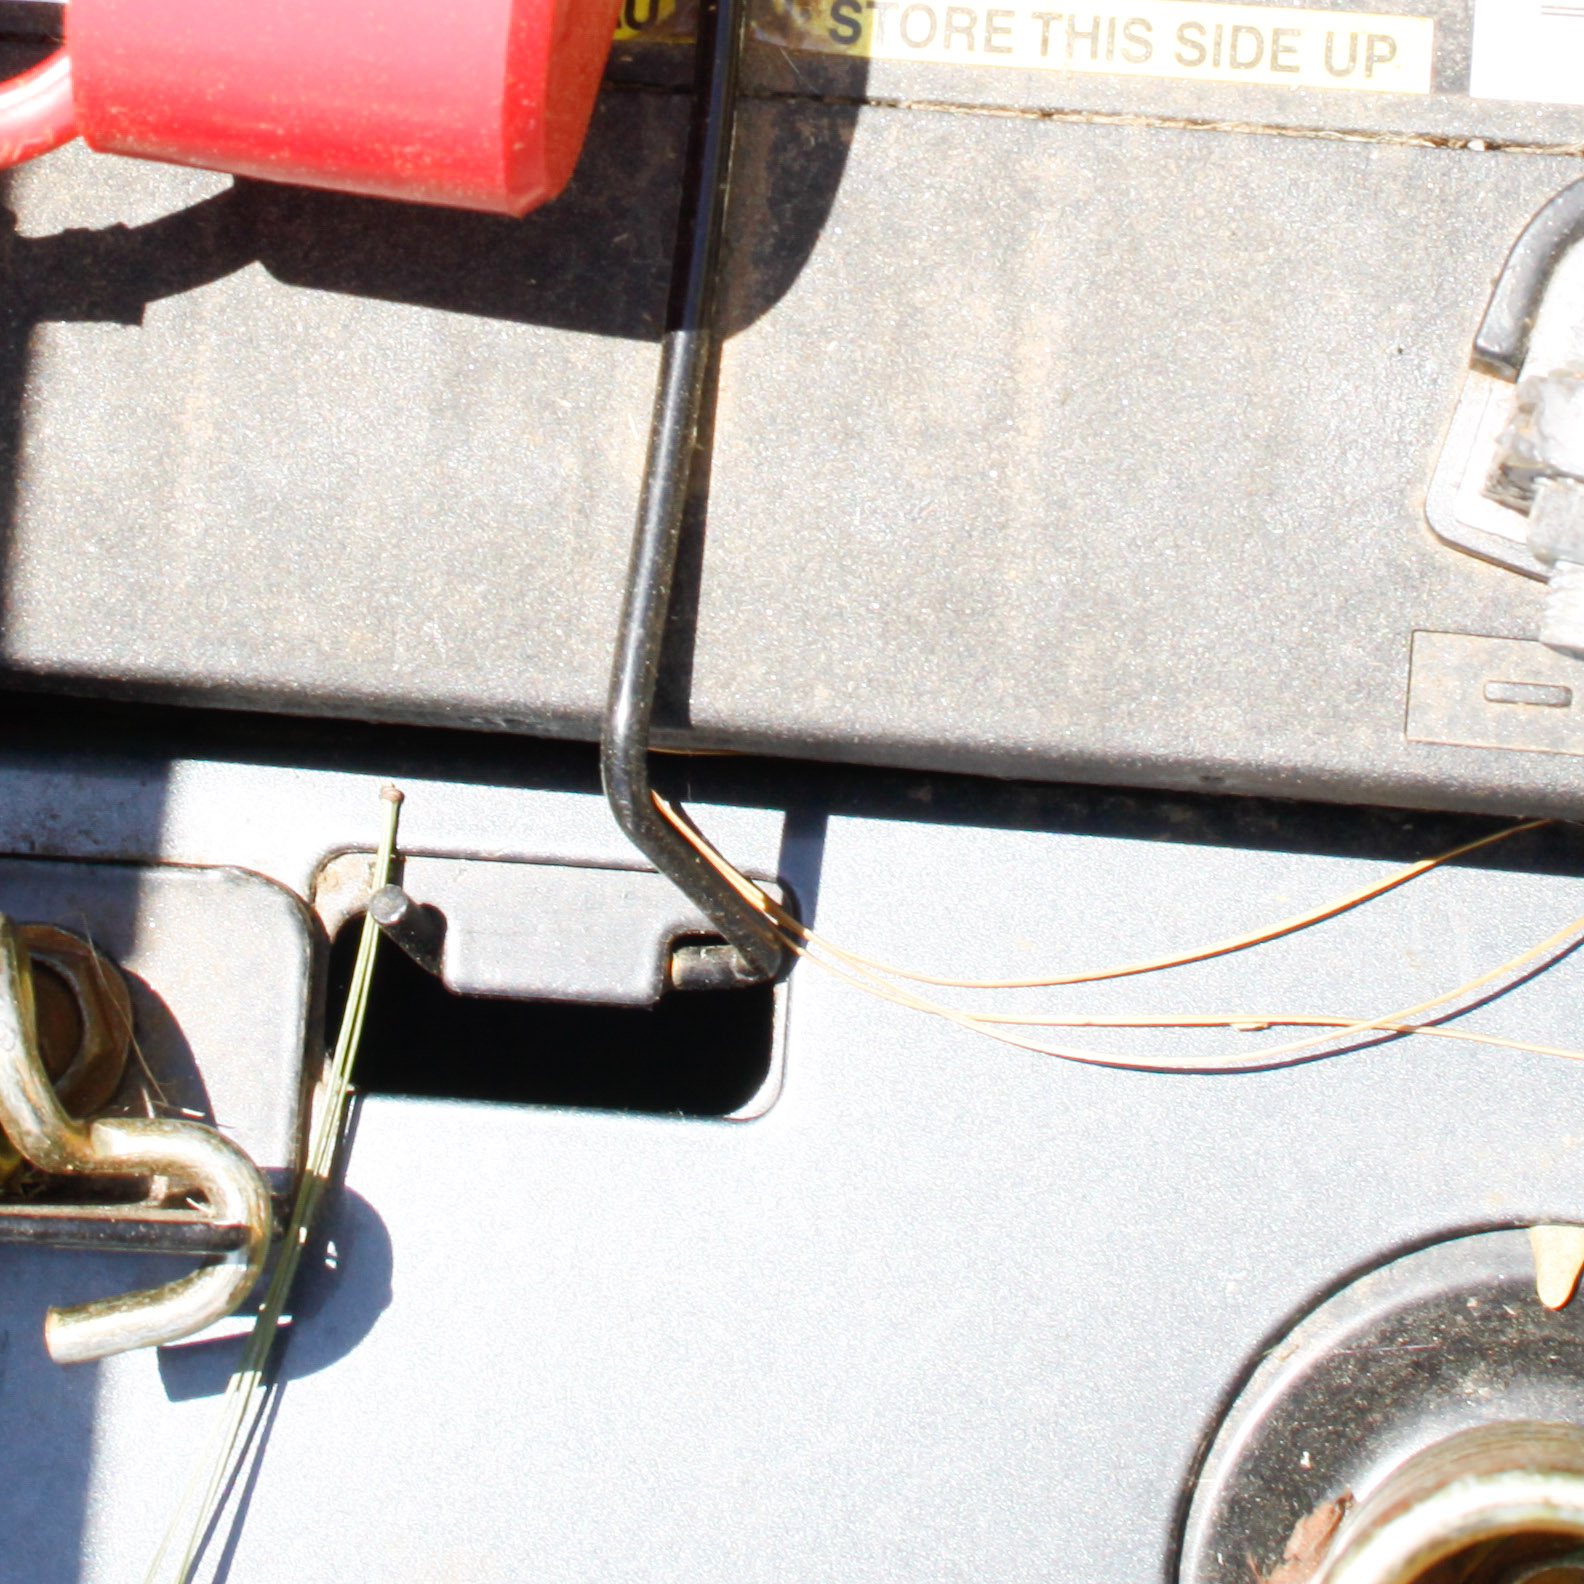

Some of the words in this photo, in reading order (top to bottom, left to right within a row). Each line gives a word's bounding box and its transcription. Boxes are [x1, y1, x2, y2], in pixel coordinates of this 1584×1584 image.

[1029, 11, 1154, 64] THIS
[1174, 20, 1302, 74] SIDE
[1323, 29, 1398, 79] UP
